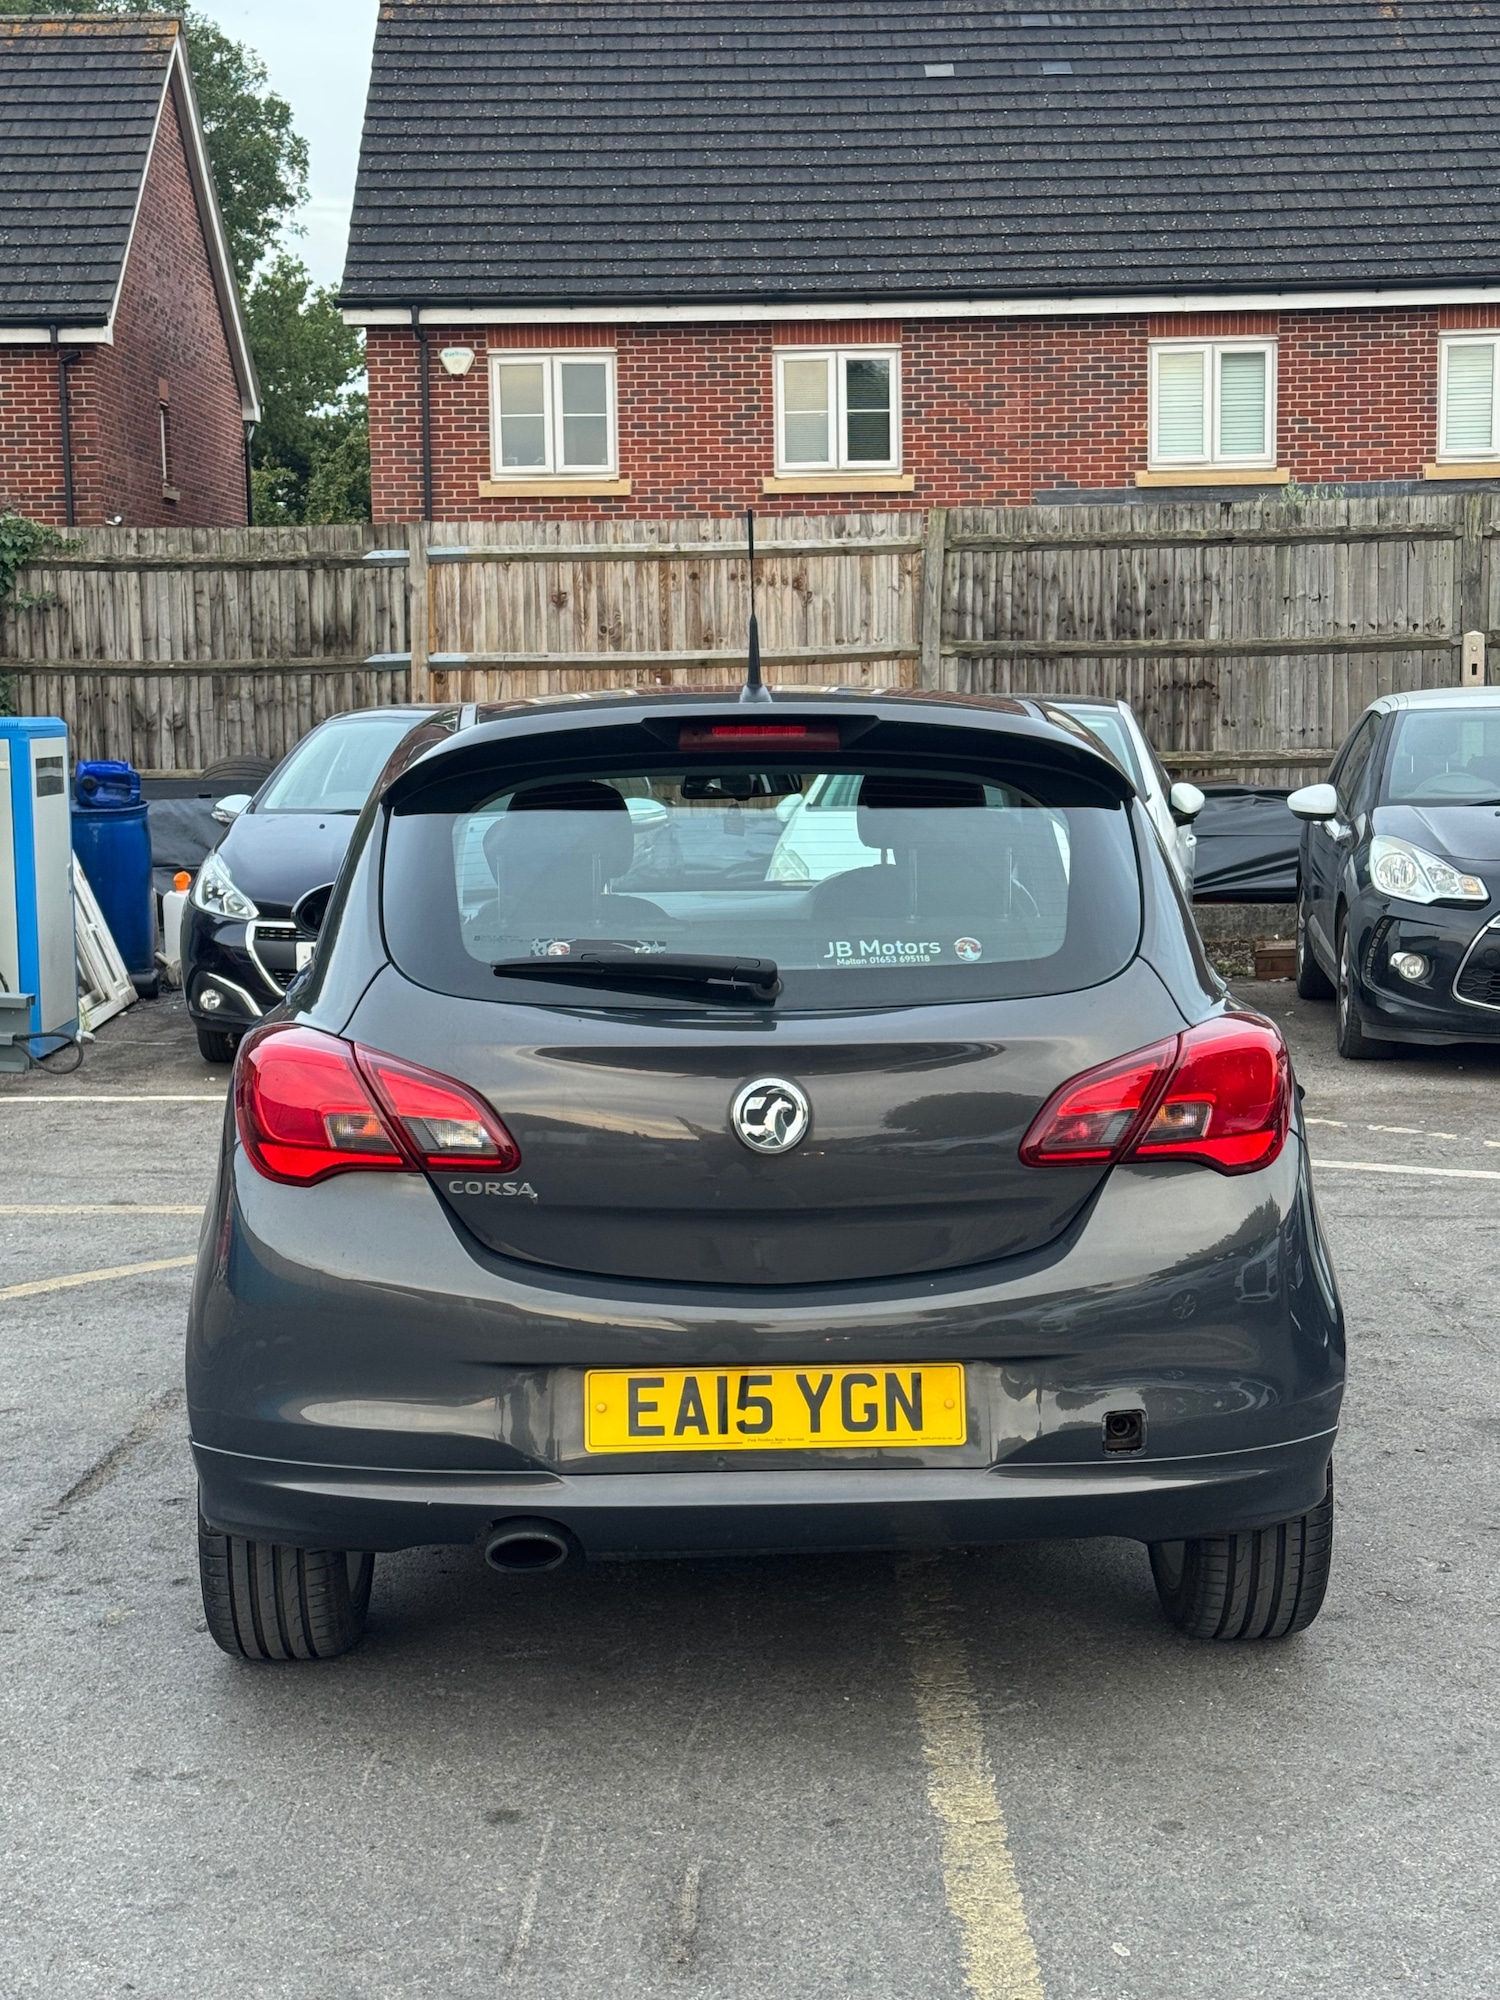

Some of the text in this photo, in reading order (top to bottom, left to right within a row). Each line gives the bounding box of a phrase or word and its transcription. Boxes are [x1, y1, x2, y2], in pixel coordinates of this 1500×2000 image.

[823, 939, 942, 958] JB Motors
[836, 955, 931, 966] Malton 01653 695118
[448, 1180, 536, 1196] CORSA
[627, 1372, 924, 1437] EA15 YGN
